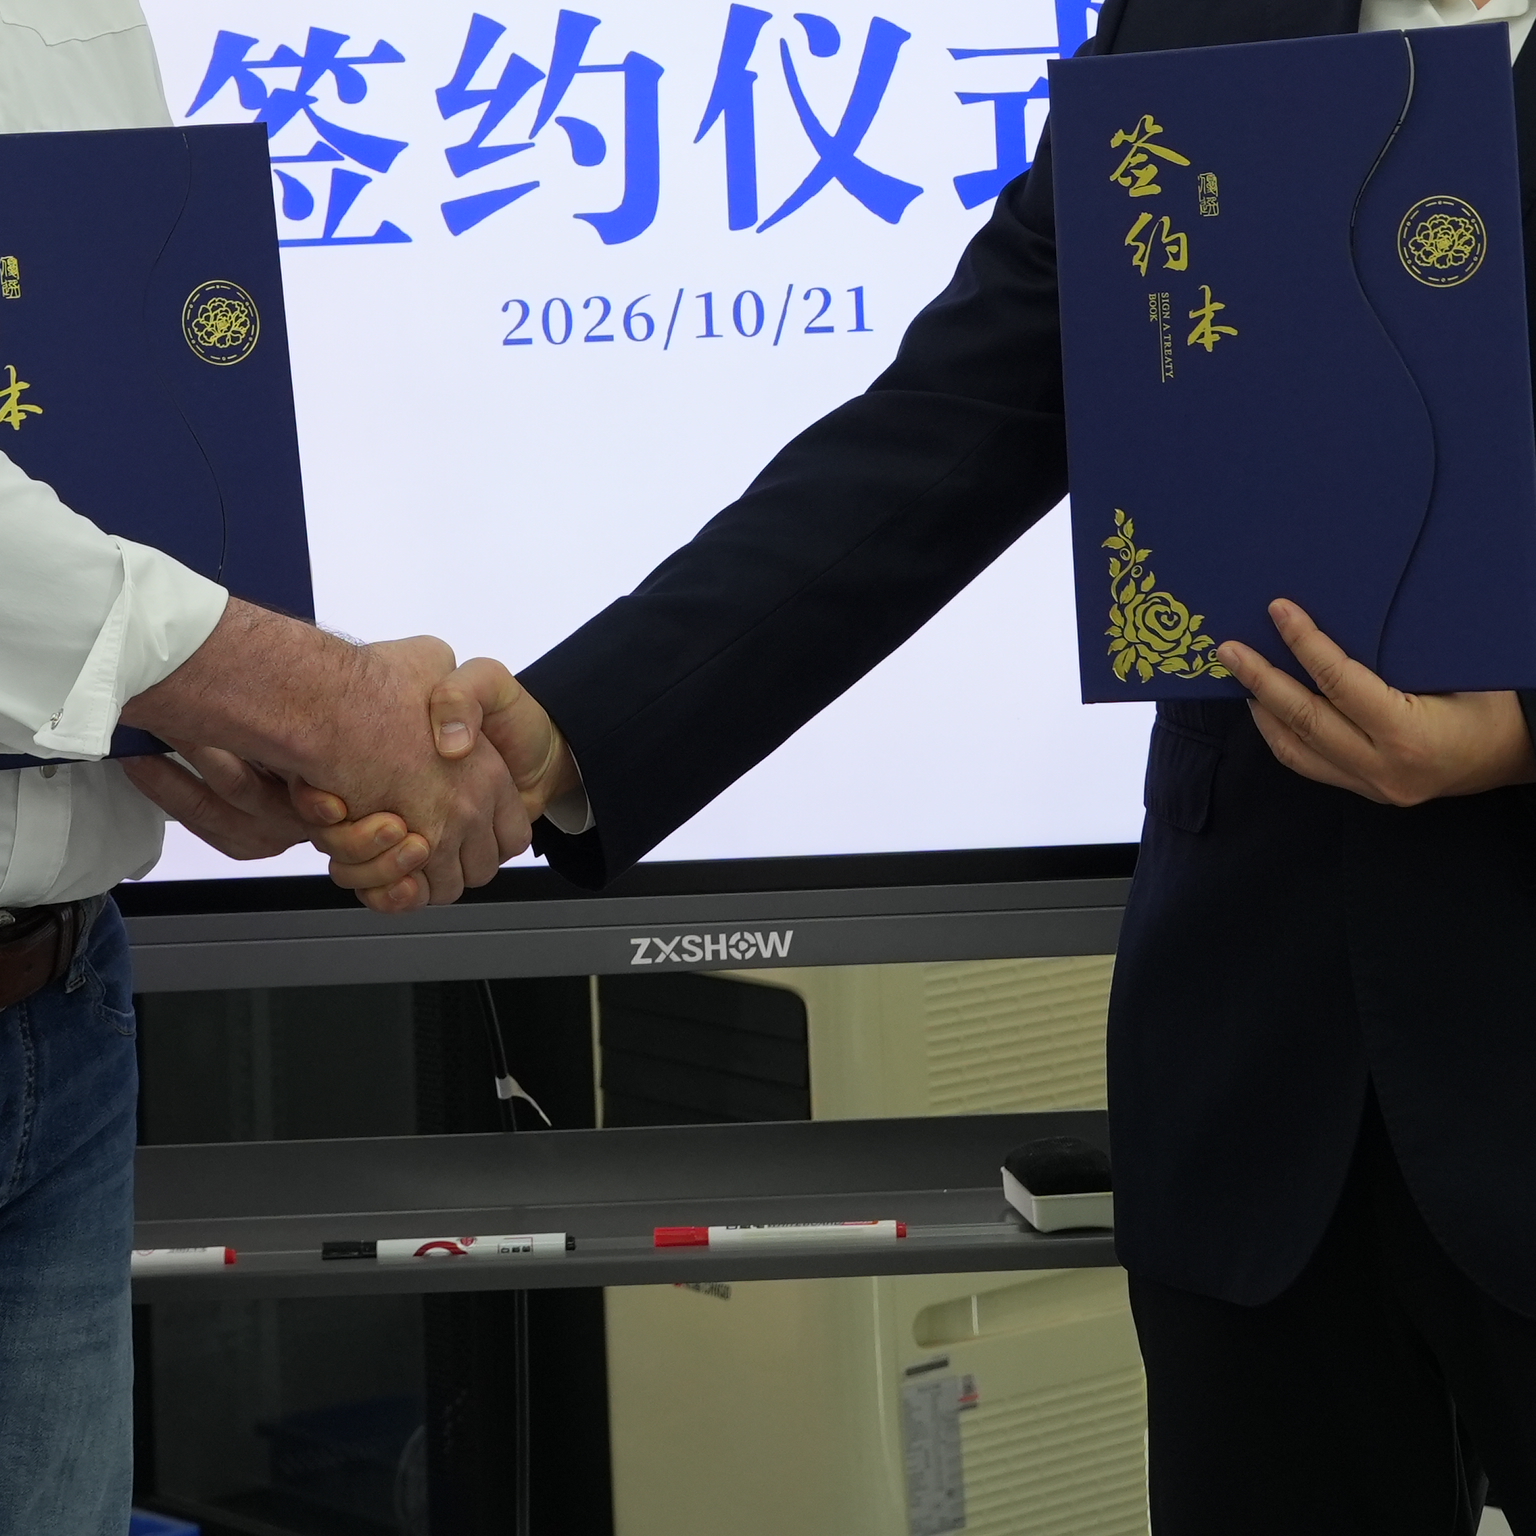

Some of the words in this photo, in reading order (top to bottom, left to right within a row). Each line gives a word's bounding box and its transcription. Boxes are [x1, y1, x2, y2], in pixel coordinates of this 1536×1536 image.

[1109, 114, 1238, 352] 签约本
[501, 285, 874, 350] 2026/10/21
[1148, 293, 1158, 322] BOOK
[1161, 292, 1170, 319] SIGN
[1163, 323, 1171, 331] A
[1164, 334, 1174, 378] TREATY
[630, 930, 794, 965] ZXSHOW
